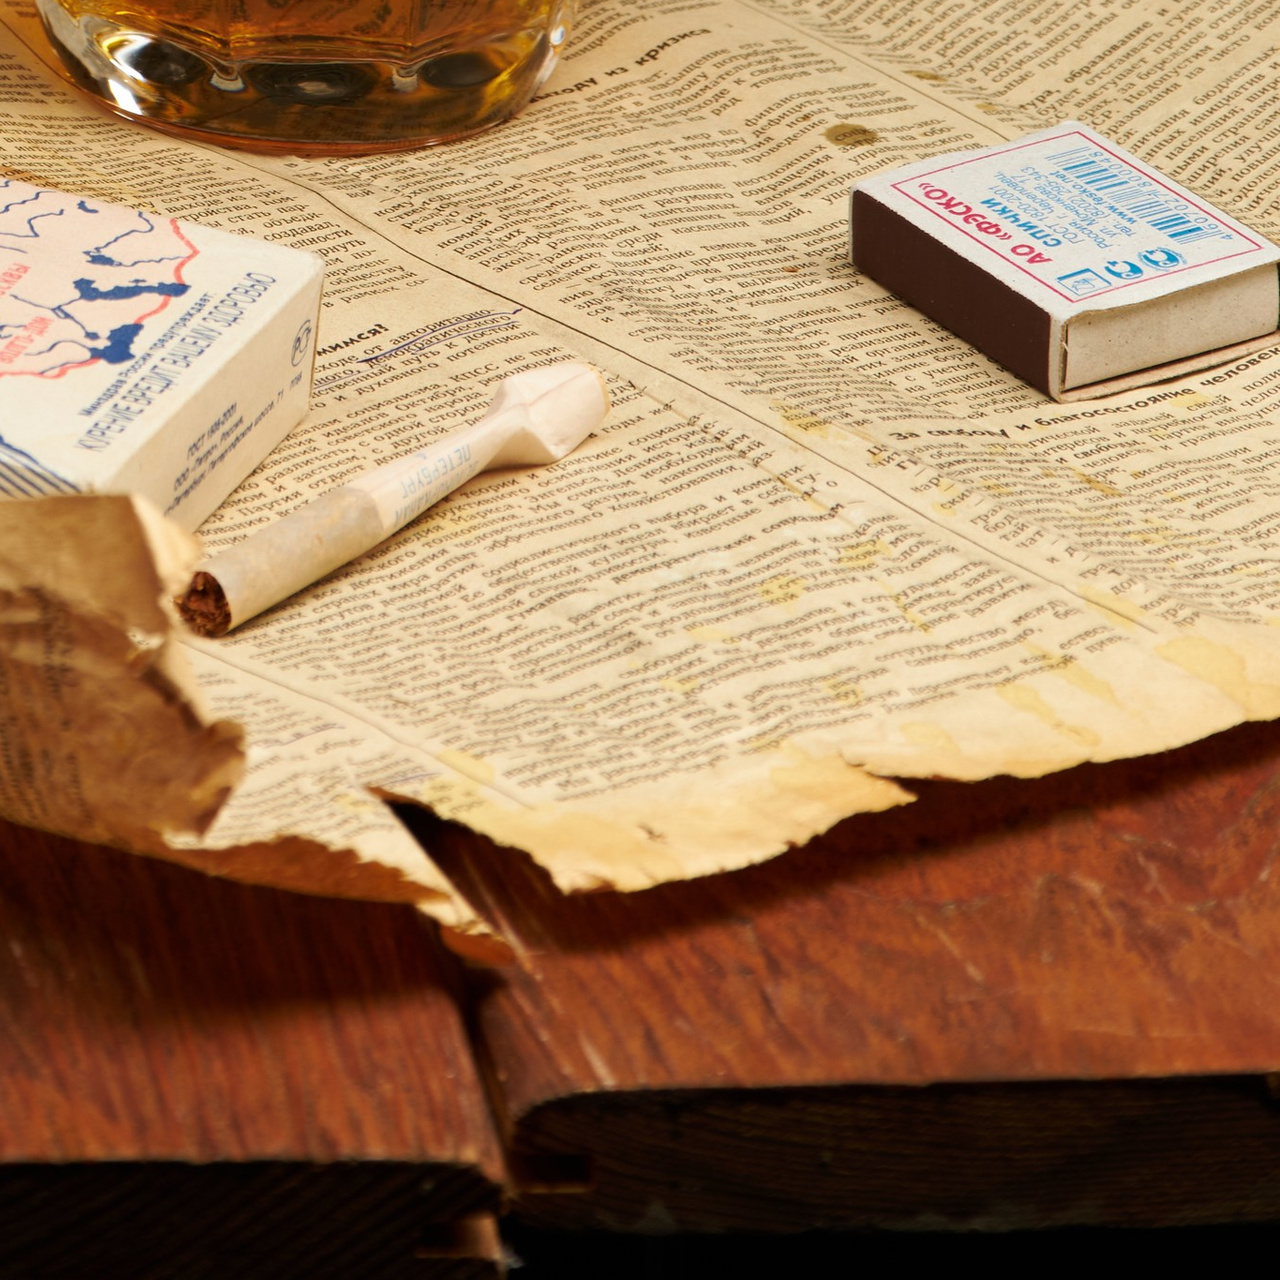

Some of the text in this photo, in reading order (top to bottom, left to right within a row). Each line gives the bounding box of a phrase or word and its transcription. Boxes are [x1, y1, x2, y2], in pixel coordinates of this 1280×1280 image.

[604, 65, 630, 78] из
[634, 26, 712, 68] кризиса
[1063, 19, 1154, 85] образование
[1136, 30, 1208, 82] бережное
[1122, 44, 1214, 106] Недопустим
[1192, 45, 1279, 107] бюджетных
[1164, 105, 1246, 161] населения;
[732, 143, 824, 186] неотложных
[740, 153, 833, 198] сокращения
[1021, 166, 1072, 198] 295-343
[598, 180, 727, 208] финансирование
[654, 191, 734, 208] разумного
[988, 185, 1085, 244] ГОСТ 1820-2001
[1050, 170, 1138, 225] www.fesko.net
[1069, 194, 1111, 220] (8202)
[671, 220, 750, 236] населения
[918, 182, 1052, 264] АО «ФЭСКО»
[329, 264, 406, 287] обществу
[690, 243, 797, 268] предприятий,
[340, 285, 400, 304] рамках
[367, 314, 512, 368] демократического
[389, 307, 495, 346] авторитарно-
[447, 329, 540, 363] потенциала
[73, 272, 276, 452] КУРЕНИЕ ВРЕДИТ ВАШЕМУ ЗДОРОВЬЮ
[449, 353, 526, 384] КПСС не
[1033, 386, 1197, 428] благосостояние
[446, 451, 681, 527] Маркса, Энгельса, Ленина,
[463, 477, 520, 500] теории
[544, 446, 623, 474] практике
[537, 453, 637, 488] осмысления
[481, 521, 641, 579] социалистического
